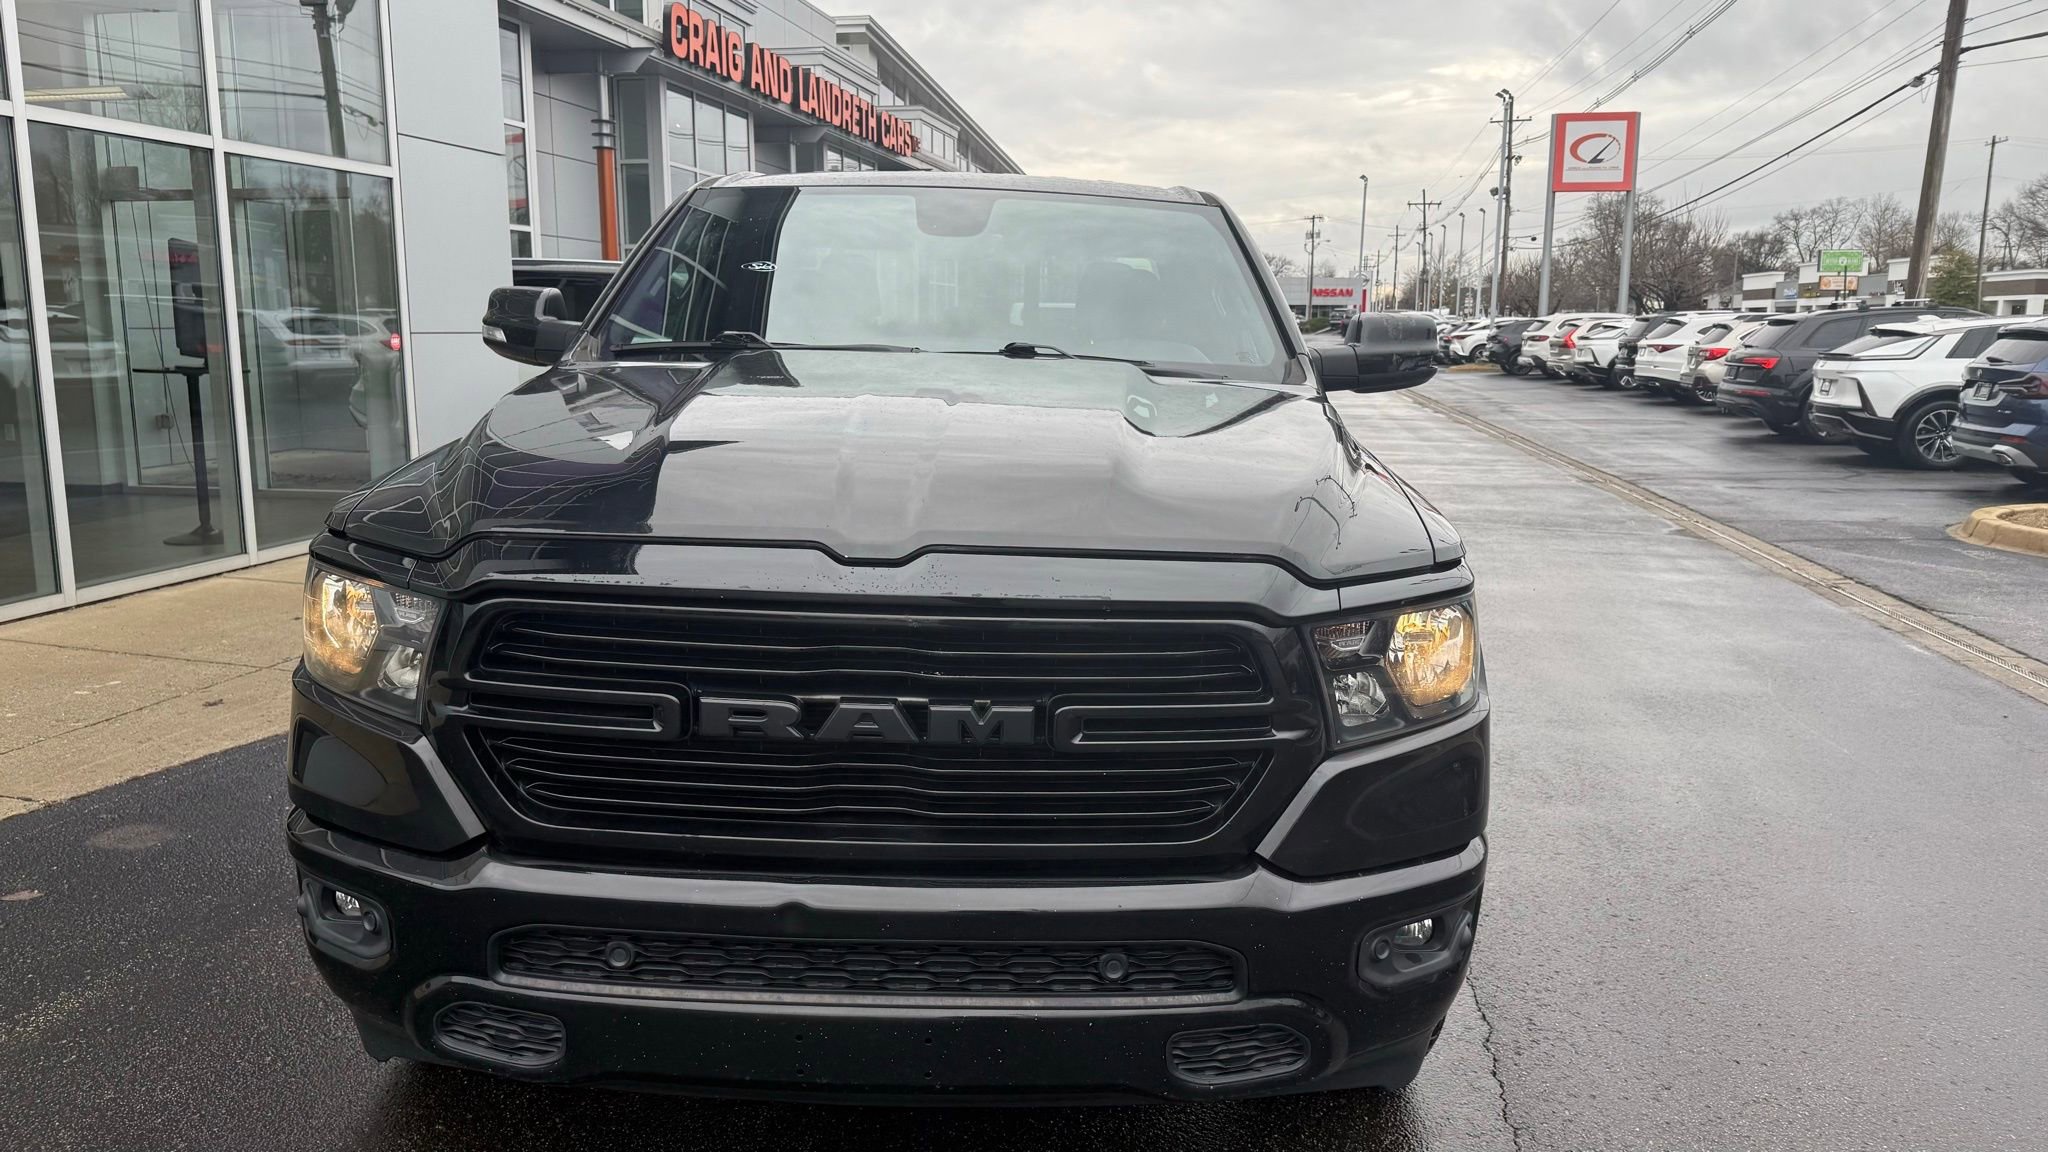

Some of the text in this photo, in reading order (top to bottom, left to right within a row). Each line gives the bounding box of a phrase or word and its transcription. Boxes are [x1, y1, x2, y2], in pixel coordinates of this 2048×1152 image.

[669, 2, 912, 157] CRAIG AND LANDRETH CARS
[1311, 287, 1354, 297] NISSAN
[699, 696, 1036, 745] RAM
